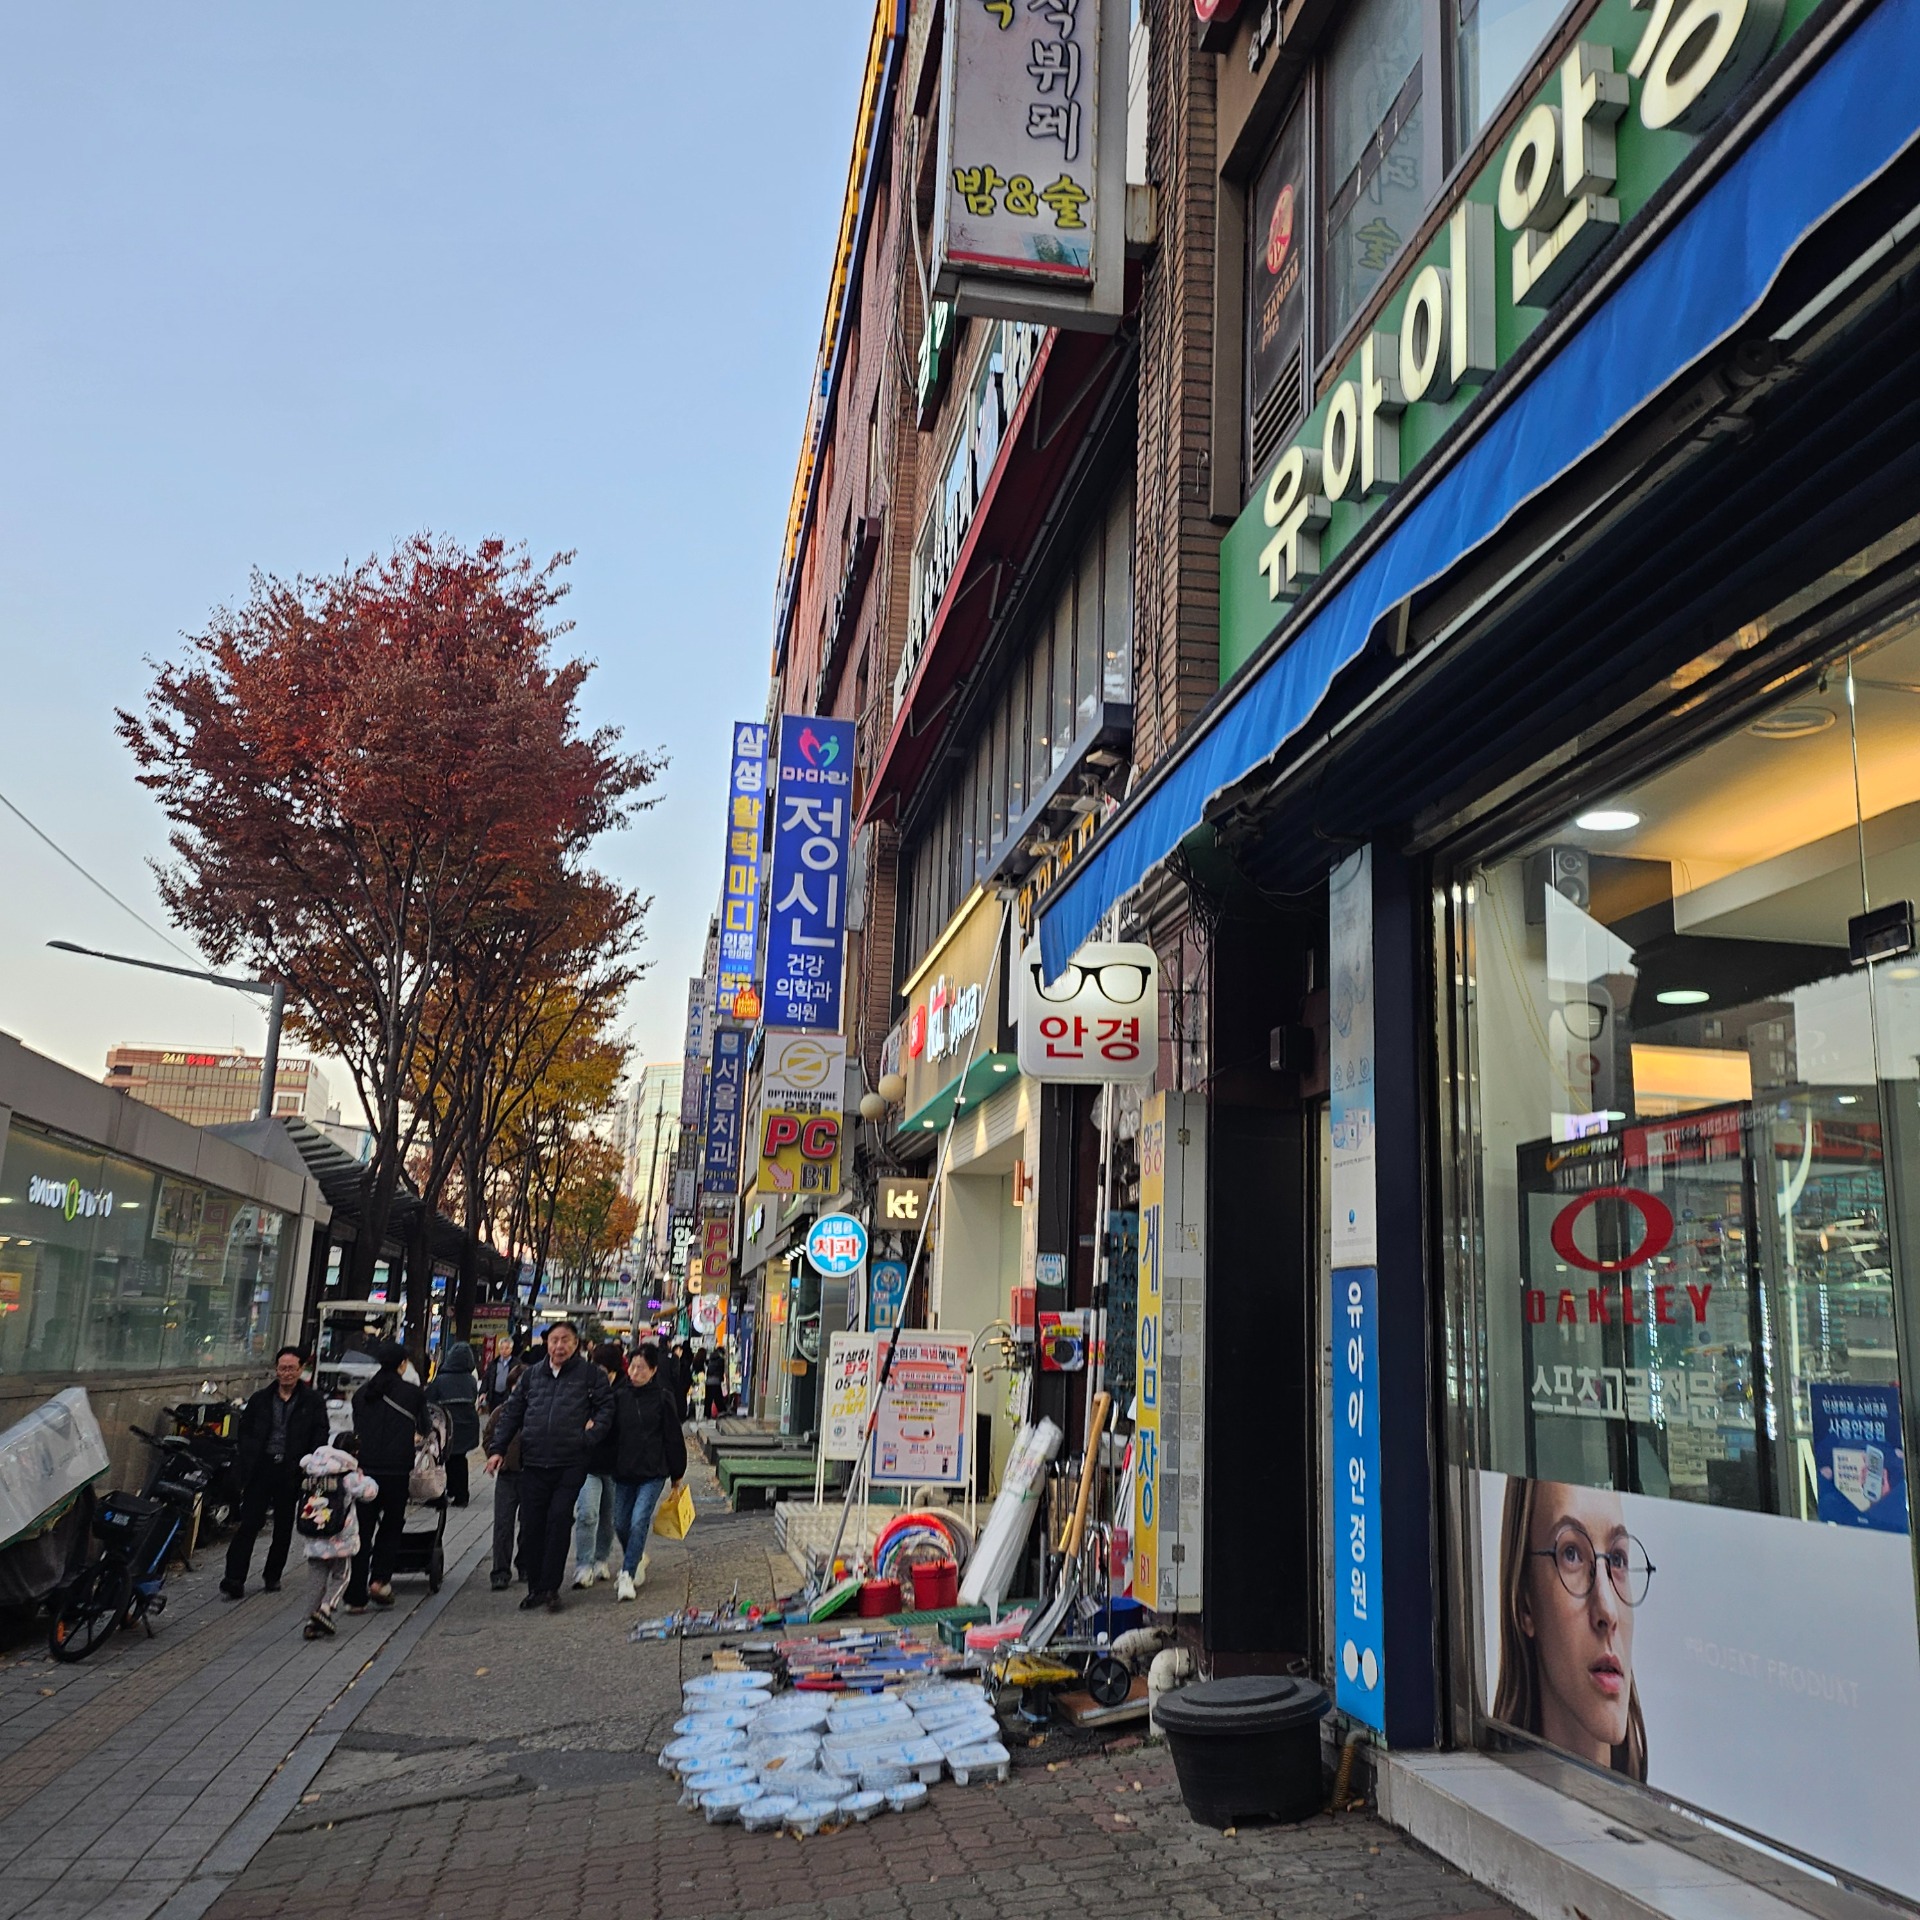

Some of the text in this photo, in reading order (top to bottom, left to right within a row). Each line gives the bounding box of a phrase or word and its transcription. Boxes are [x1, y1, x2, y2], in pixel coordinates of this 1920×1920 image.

[953, 163, 1090, 229] 밤&술
[1263, 257, 1299, 333] HANAM
[1258, 200, 1490, 605] 유아이
[776, 796, 843, 948] 정신
[787, 954, 825, 976] 건강
[774, 980, 832, 1003] 의학과
[787, 1003, 817, 1023] 의원
[1039, 1015, 1141, 1063] 안경
[709, 1057, 739, 1169] 서울치과
[768, 1089, 837, 1101] OPTIMUM ZONE
[764, 1114, 840, 1161] PC
[801, 1162, 832, 1191] B1
[887, 1189, 919, 1219] kt
[704, 1221, 729, 1278] PC
[812, 1236, 861, 1261] 치과
[1525, 1284, 1712, 1325] OAKLEY
[1133, 1203, 1161, 1527] 게임장
[1347, 1281, 1368, 1621] 유아이 안경원
[1140, 1554, 1151, 1584] B1
